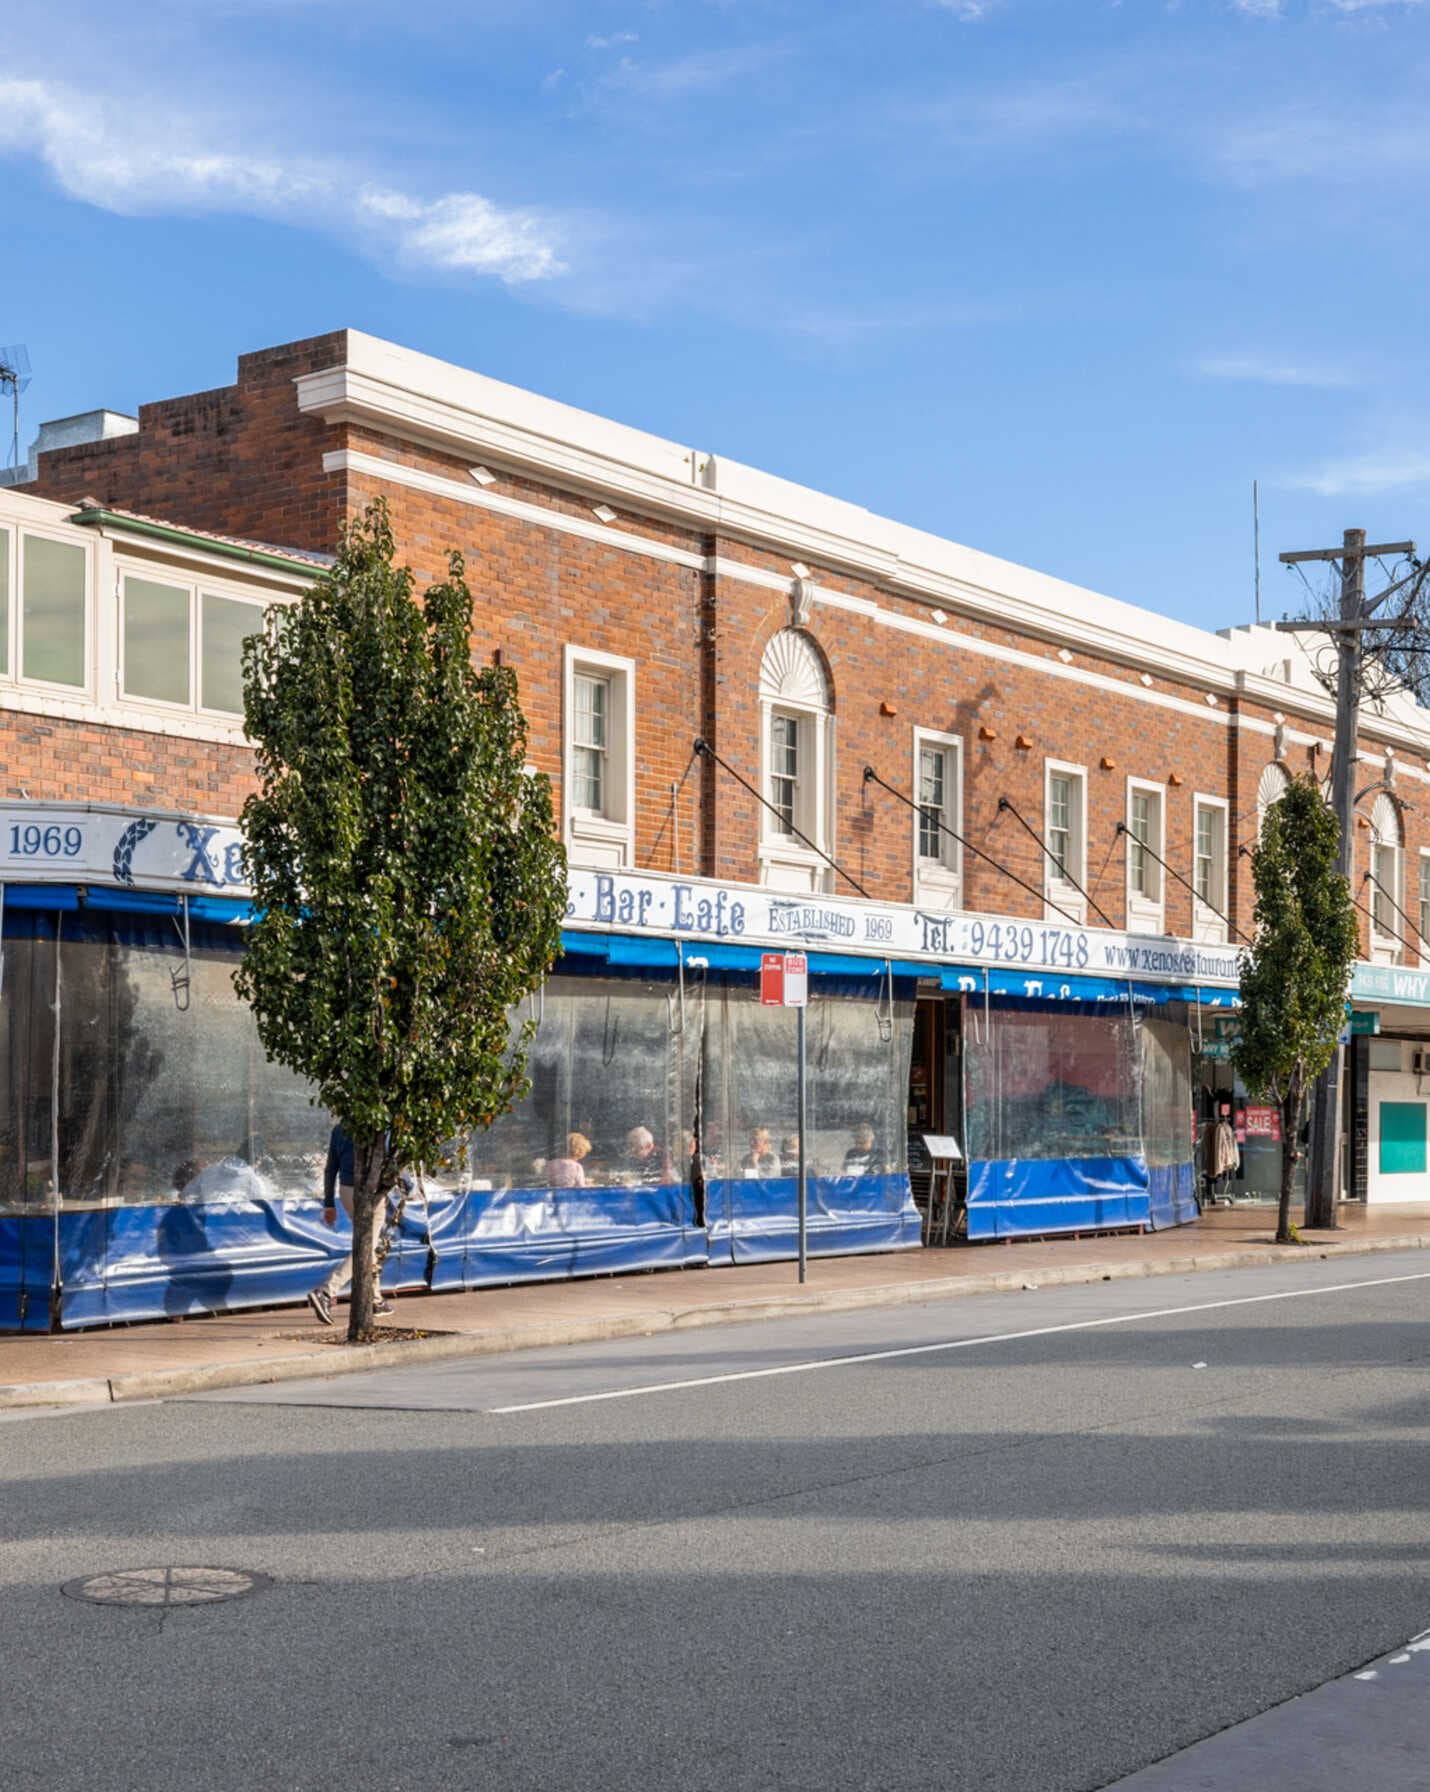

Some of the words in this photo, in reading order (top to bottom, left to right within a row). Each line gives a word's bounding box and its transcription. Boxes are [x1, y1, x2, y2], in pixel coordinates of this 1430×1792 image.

[9, 824, 82, 856] 1969
[592, 874, 652, 926] Bar
[865, 917, 893, 939] 1969
[971, 921, 1034, 961] 9439
[1040, 930, 1089, 969] 1748
[1393, 972, 1429, 1000] WHY
[1246, 1116, 1271, 1130] SALE
